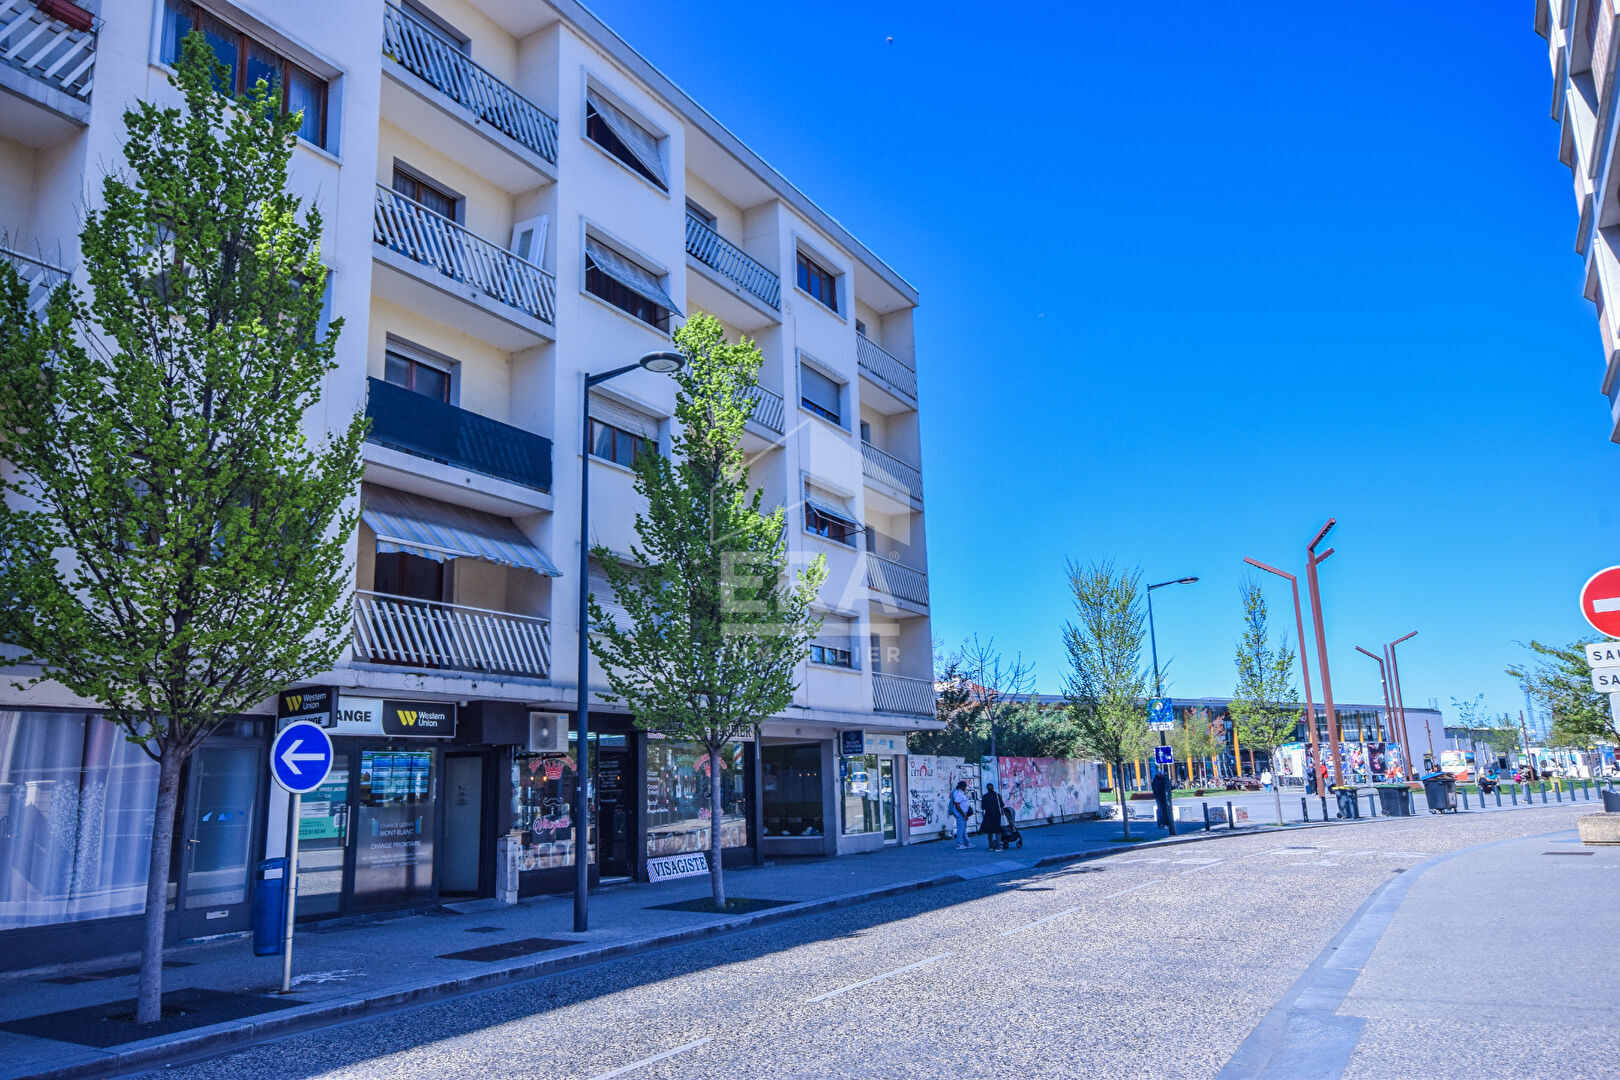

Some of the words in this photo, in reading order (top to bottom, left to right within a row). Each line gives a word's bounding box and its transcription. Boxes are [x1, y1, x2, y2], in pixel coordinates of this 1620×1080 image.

[1593, 649, 1620, 661] SA
[302, 692, 327, 702] Western
[302, 702, 319, 710] Union
[418, 711, 445, 720] Western
[418, 719, 438, 728] Union
[652, 856, 707, 877] VISAGISTE
